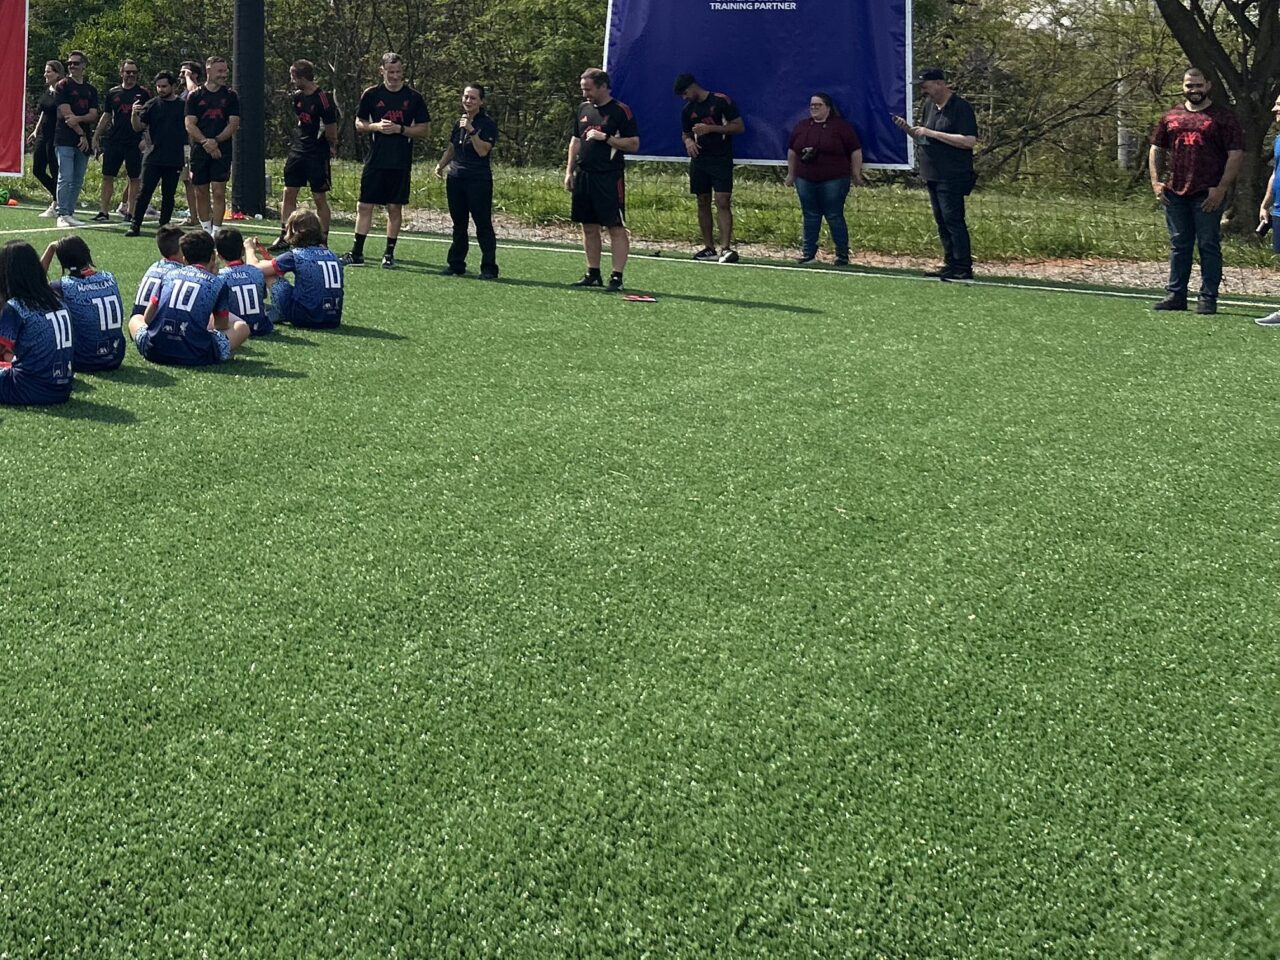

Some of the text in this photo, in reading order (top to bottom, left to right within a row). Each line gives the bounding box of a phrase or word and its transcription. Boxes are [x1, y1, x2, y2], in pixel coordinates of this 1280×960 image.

[709, 2, 796, 10] TRAINING PARTNER
[135, 276, 161, 306] 10
[318, 261, 341, 288] 10
[169, 279, 201, 312] 10
[232, 283, 260, 316] 10
[45, 309, 72, 350] 10
[91, 295, 121, 331] 10
